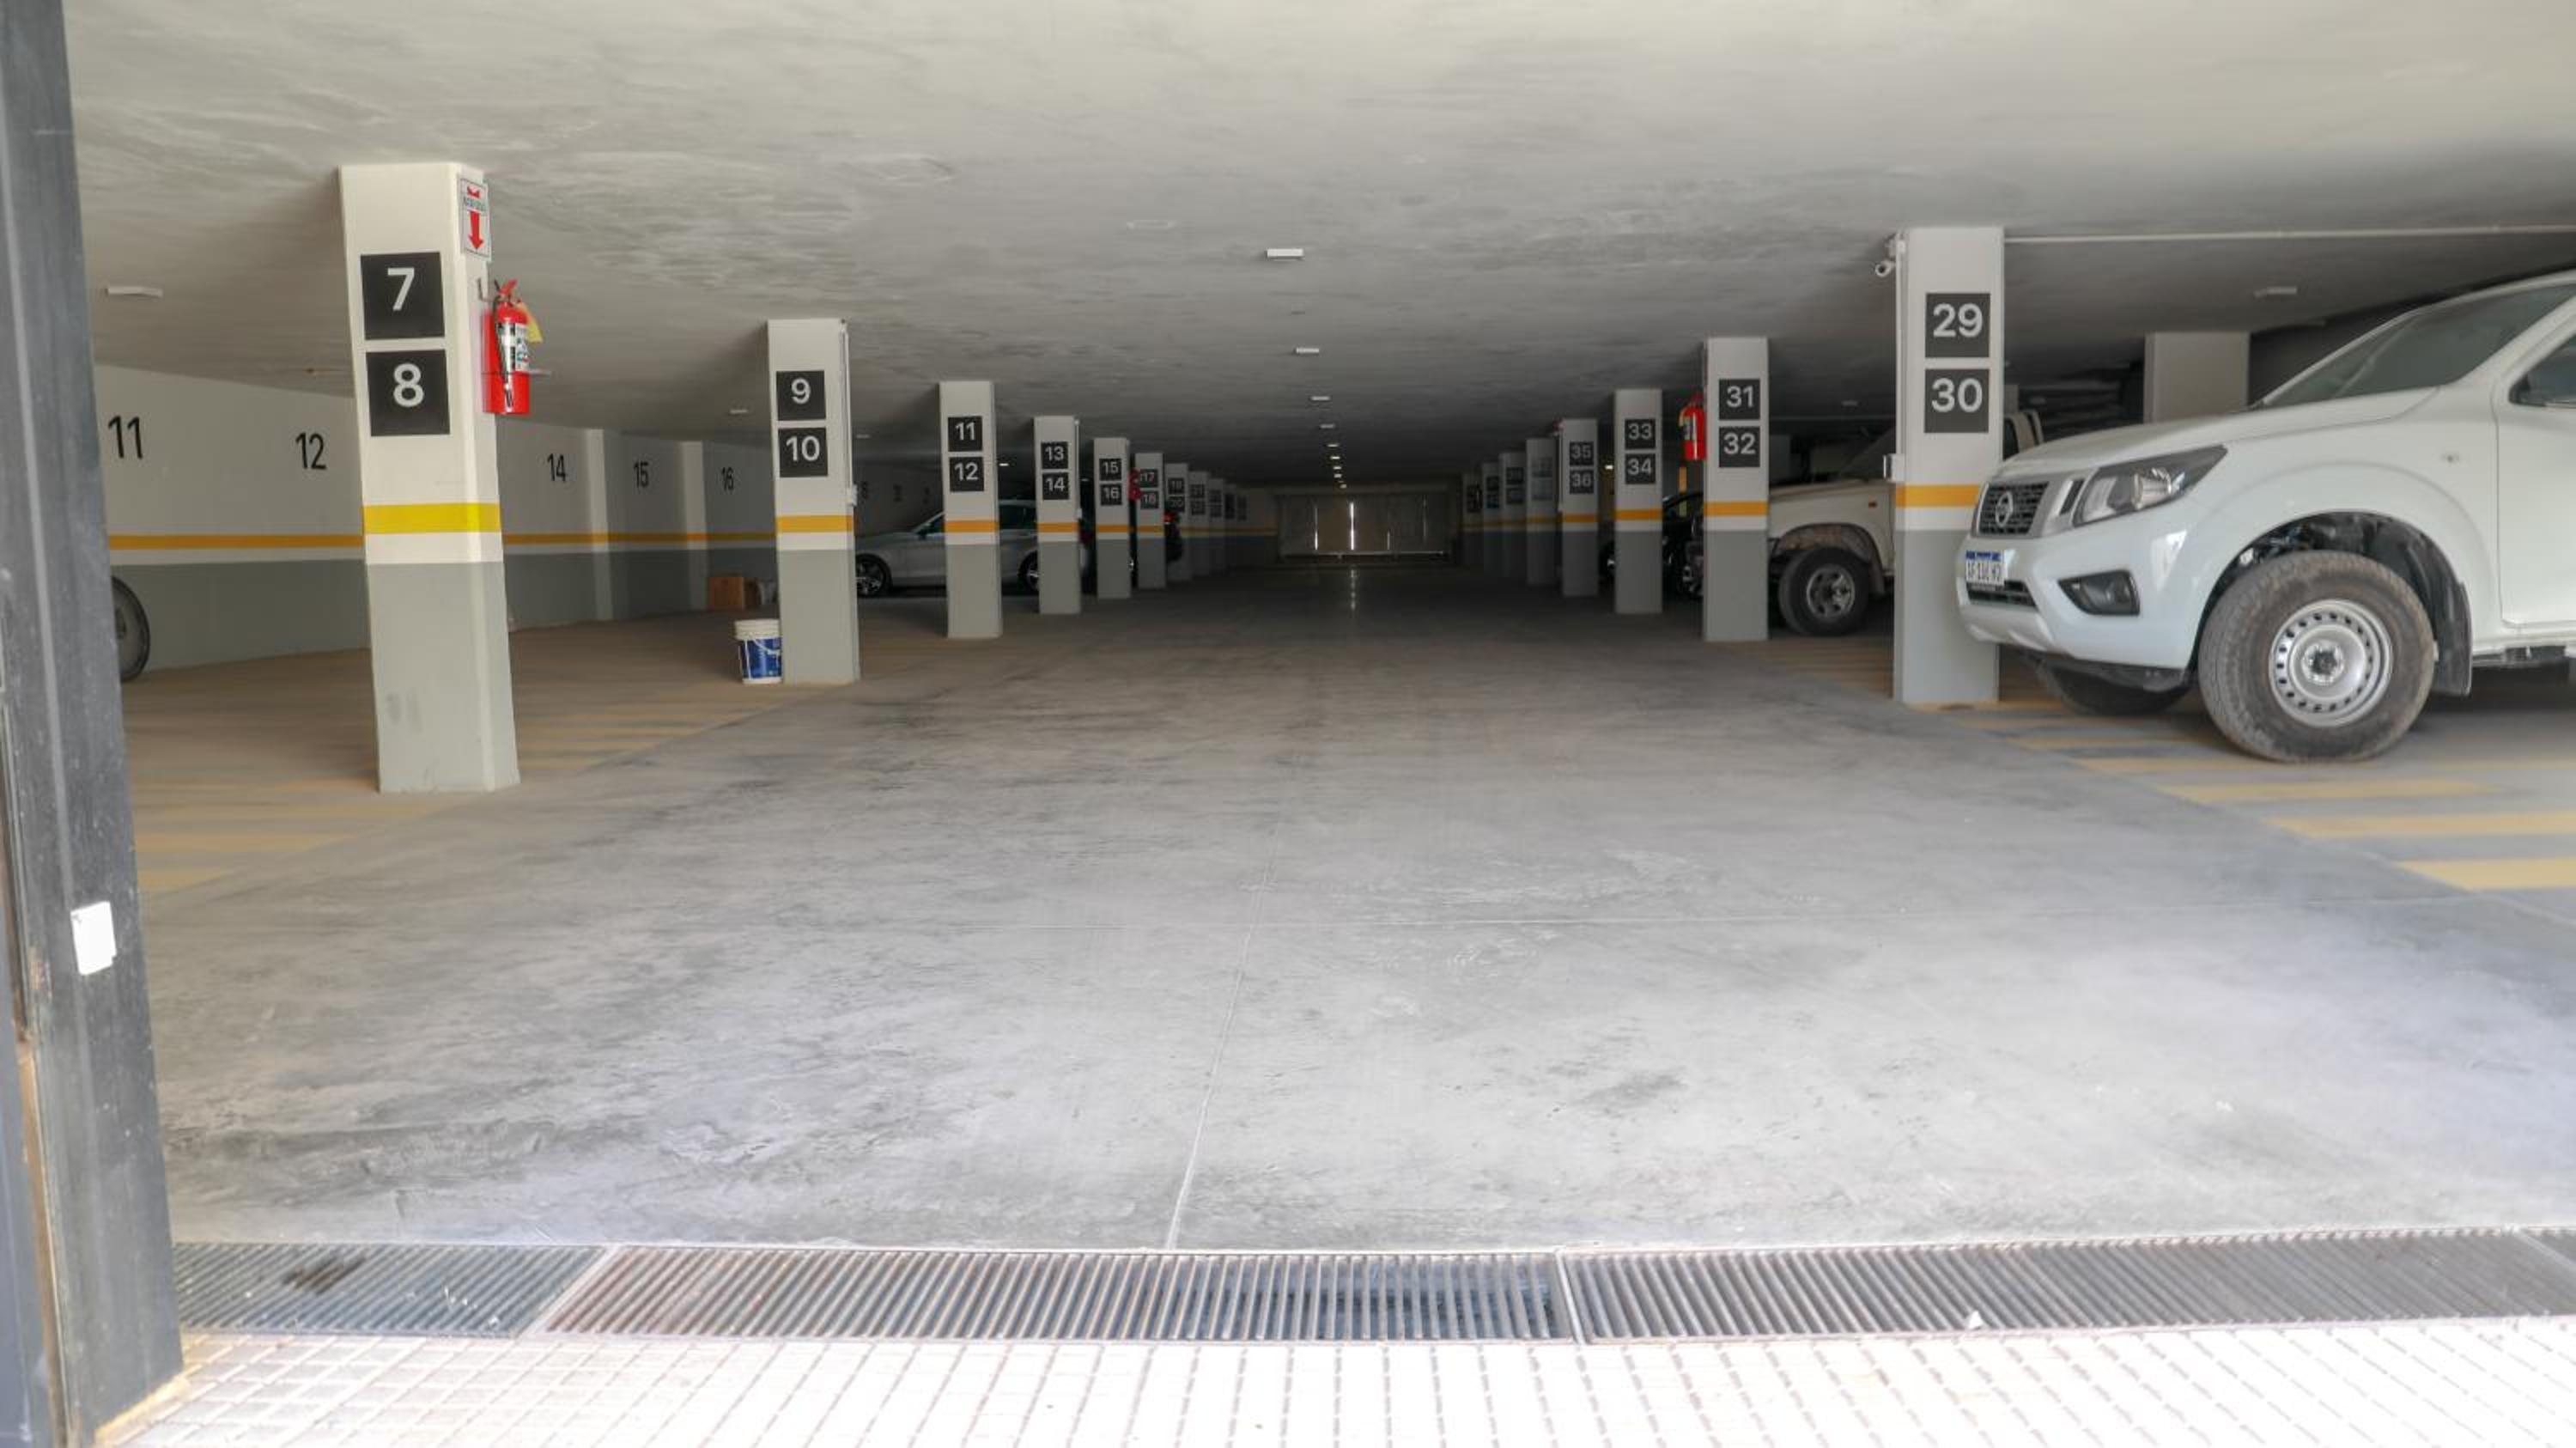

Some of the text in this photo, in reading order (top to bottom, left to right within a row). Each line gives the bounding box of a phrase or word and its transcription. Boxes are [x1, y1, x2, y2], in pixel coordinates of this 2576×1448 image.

[388, 267, 415, 310] 7
[1934, 303, 1983, 337] 29
[393, 363, 424, 407] 8
[792, 378, 811, 404] 9
[1932, 378, 1982, 412] 30
[1727, 386, 1753, 407] 31
[108, 416, 143, 459] 11
[956, 423, 975, 440] 11
[1629, 423, 1652, 440] 33
[295, 433, 326, 470] 12
[787, 436, 819, 460] 10
[1046, 446, 1064, 460] 13
[1571, 445, 1591, 459] 35
[1724, 433, 1755, 454] 32
[548, 453, 566, 482] 14
[634, 461, 649, 488] 15
[955, 462, 978, 481] 12
[1103, 462, 1118, 474] 15
[1628, 459, 1651, 475] 34
[1047, 478, 1065, 491] 14
[1104, 487, 1119, 499] 16
